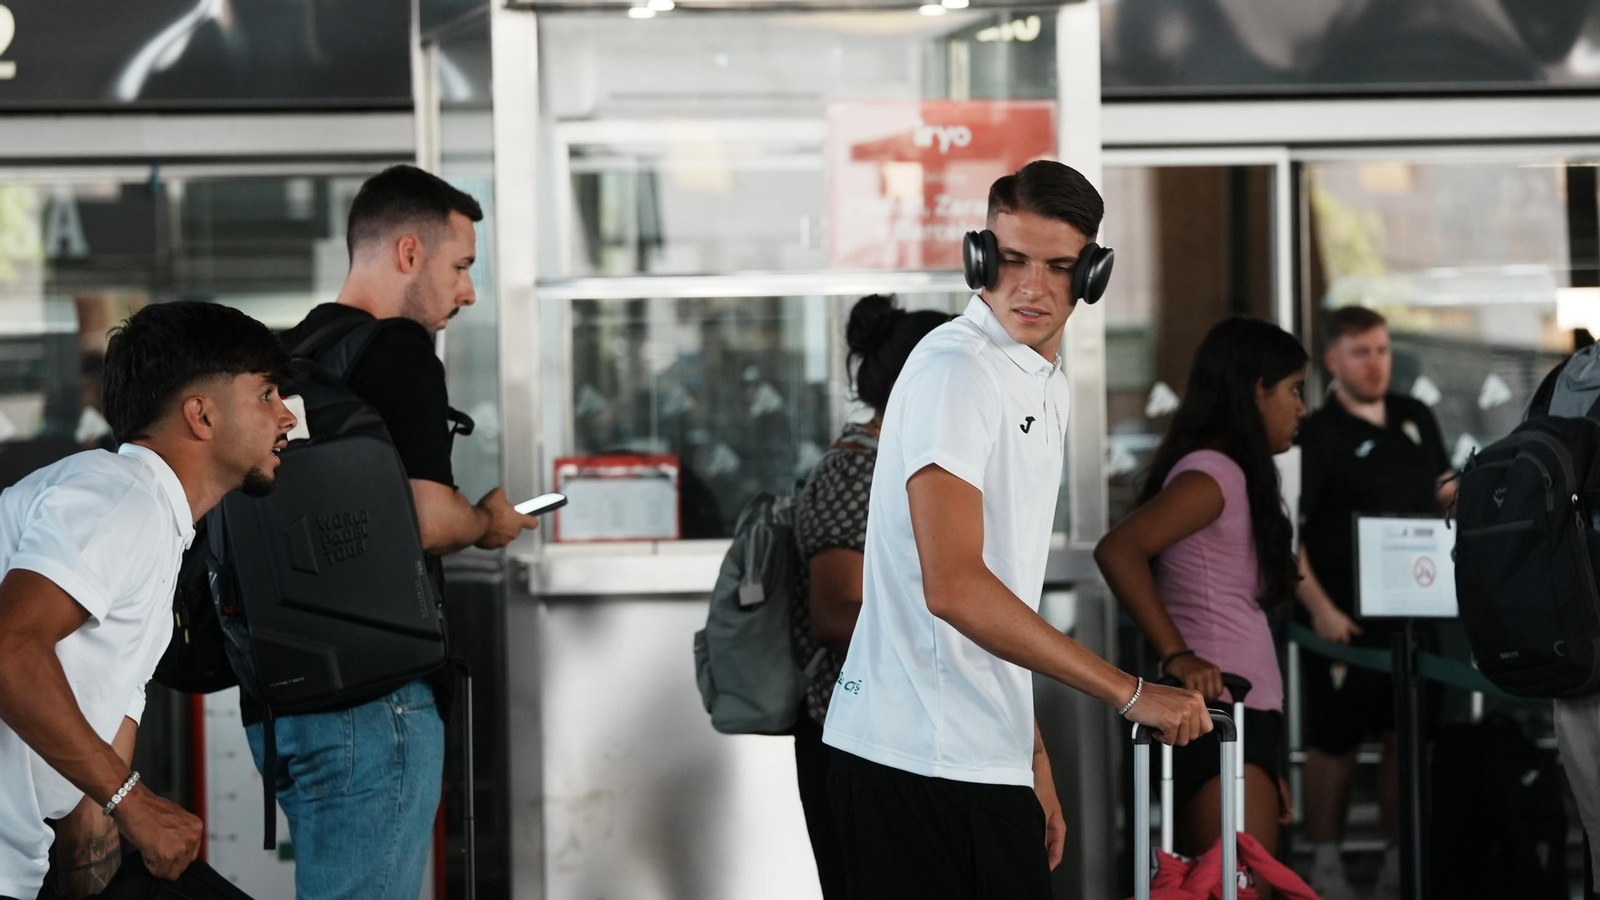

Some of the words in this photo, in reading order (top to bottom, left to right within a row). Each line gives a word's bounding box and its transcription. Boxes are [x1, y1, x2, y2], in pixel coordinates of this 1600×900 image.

[913, 119, 973, 154] iryo
[315, 508, 370, 531] WORLD
[319, 523, 370, 549] PADEL
[322, 540, 367, 566] TOUR
